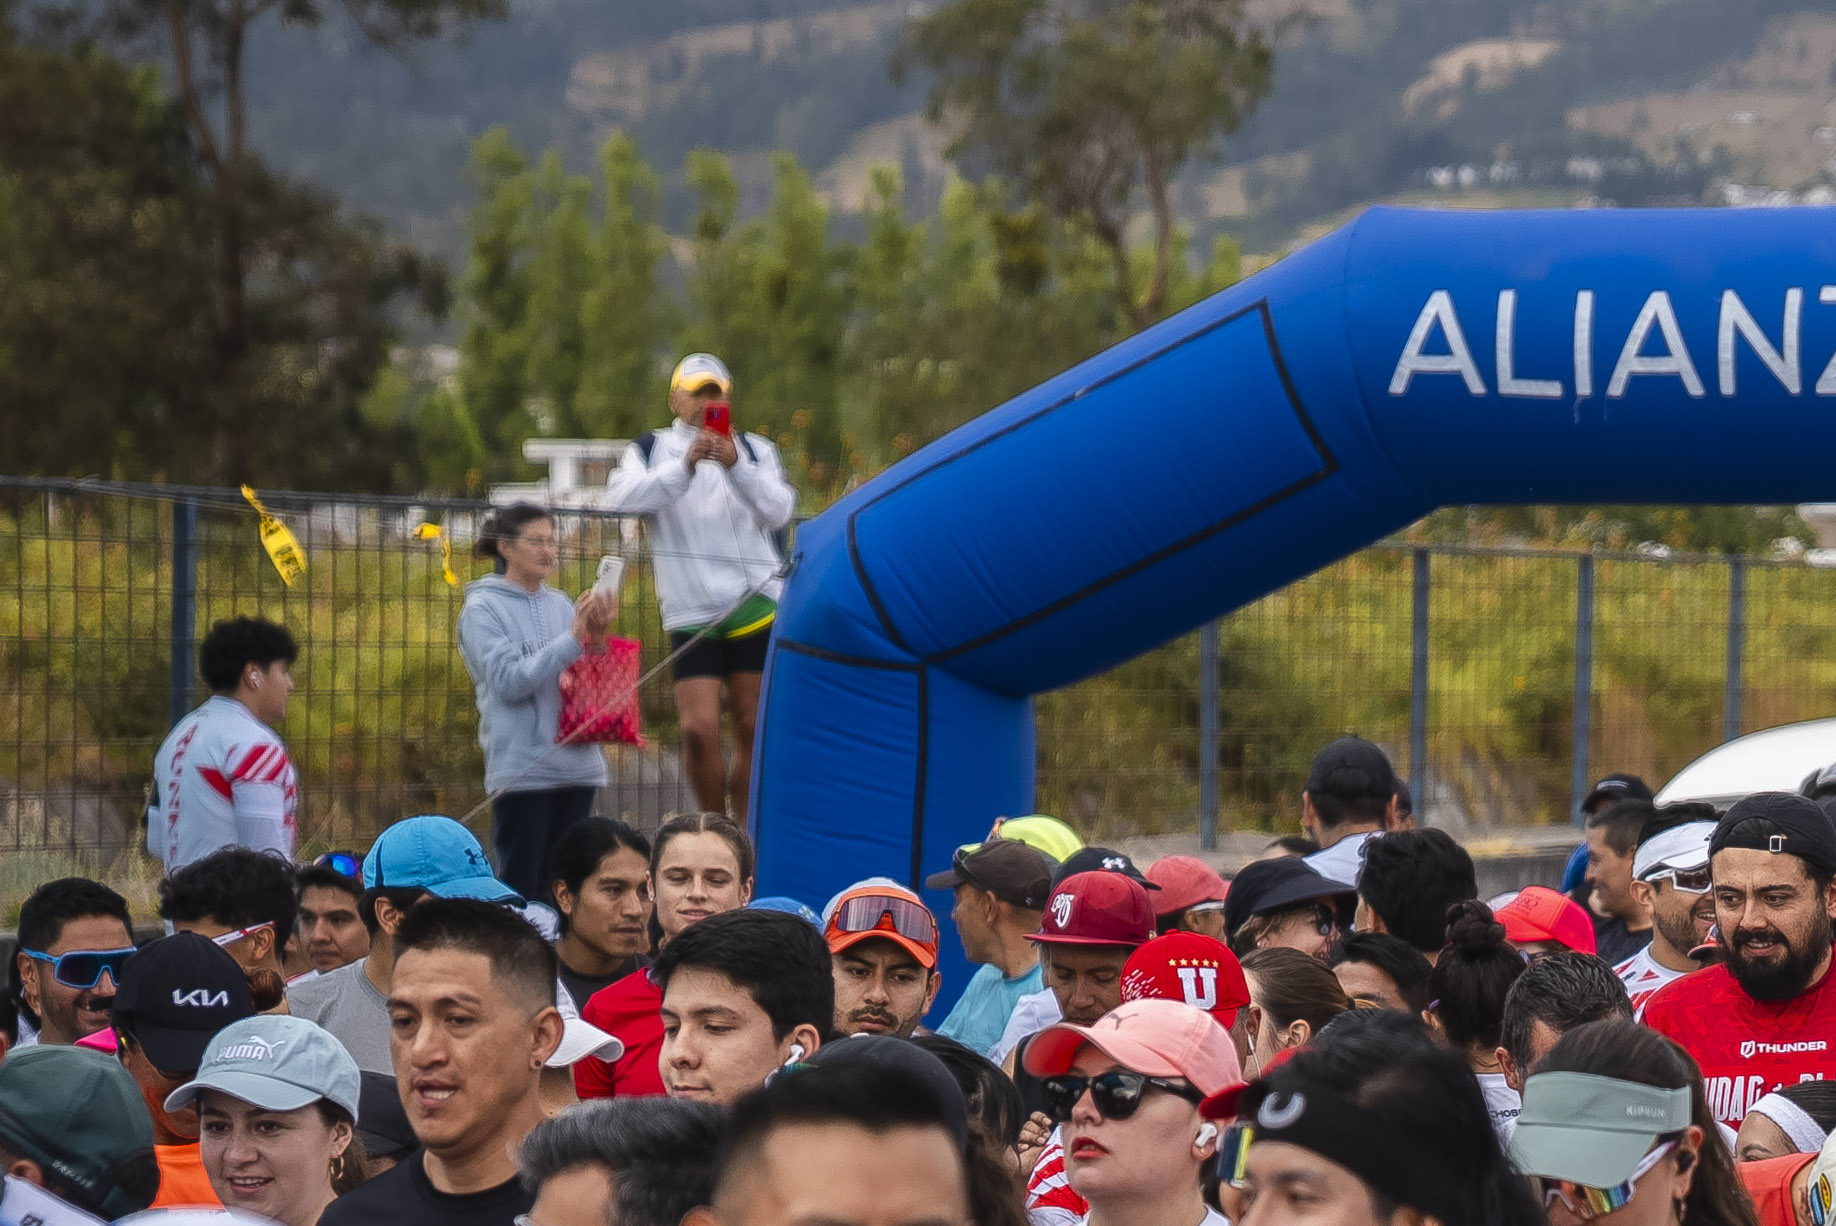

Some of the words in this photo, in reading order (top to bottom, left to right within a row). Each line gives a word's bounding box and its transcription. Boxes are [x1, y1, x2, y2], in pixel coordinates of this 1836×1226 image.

[1177, 967, 1217, 1010] U
[172, 988, 229, 1007] KIA
[216, 1044, 266, 1060] PUMA
[1757, 1040, 1827, 1053] THUNDER
